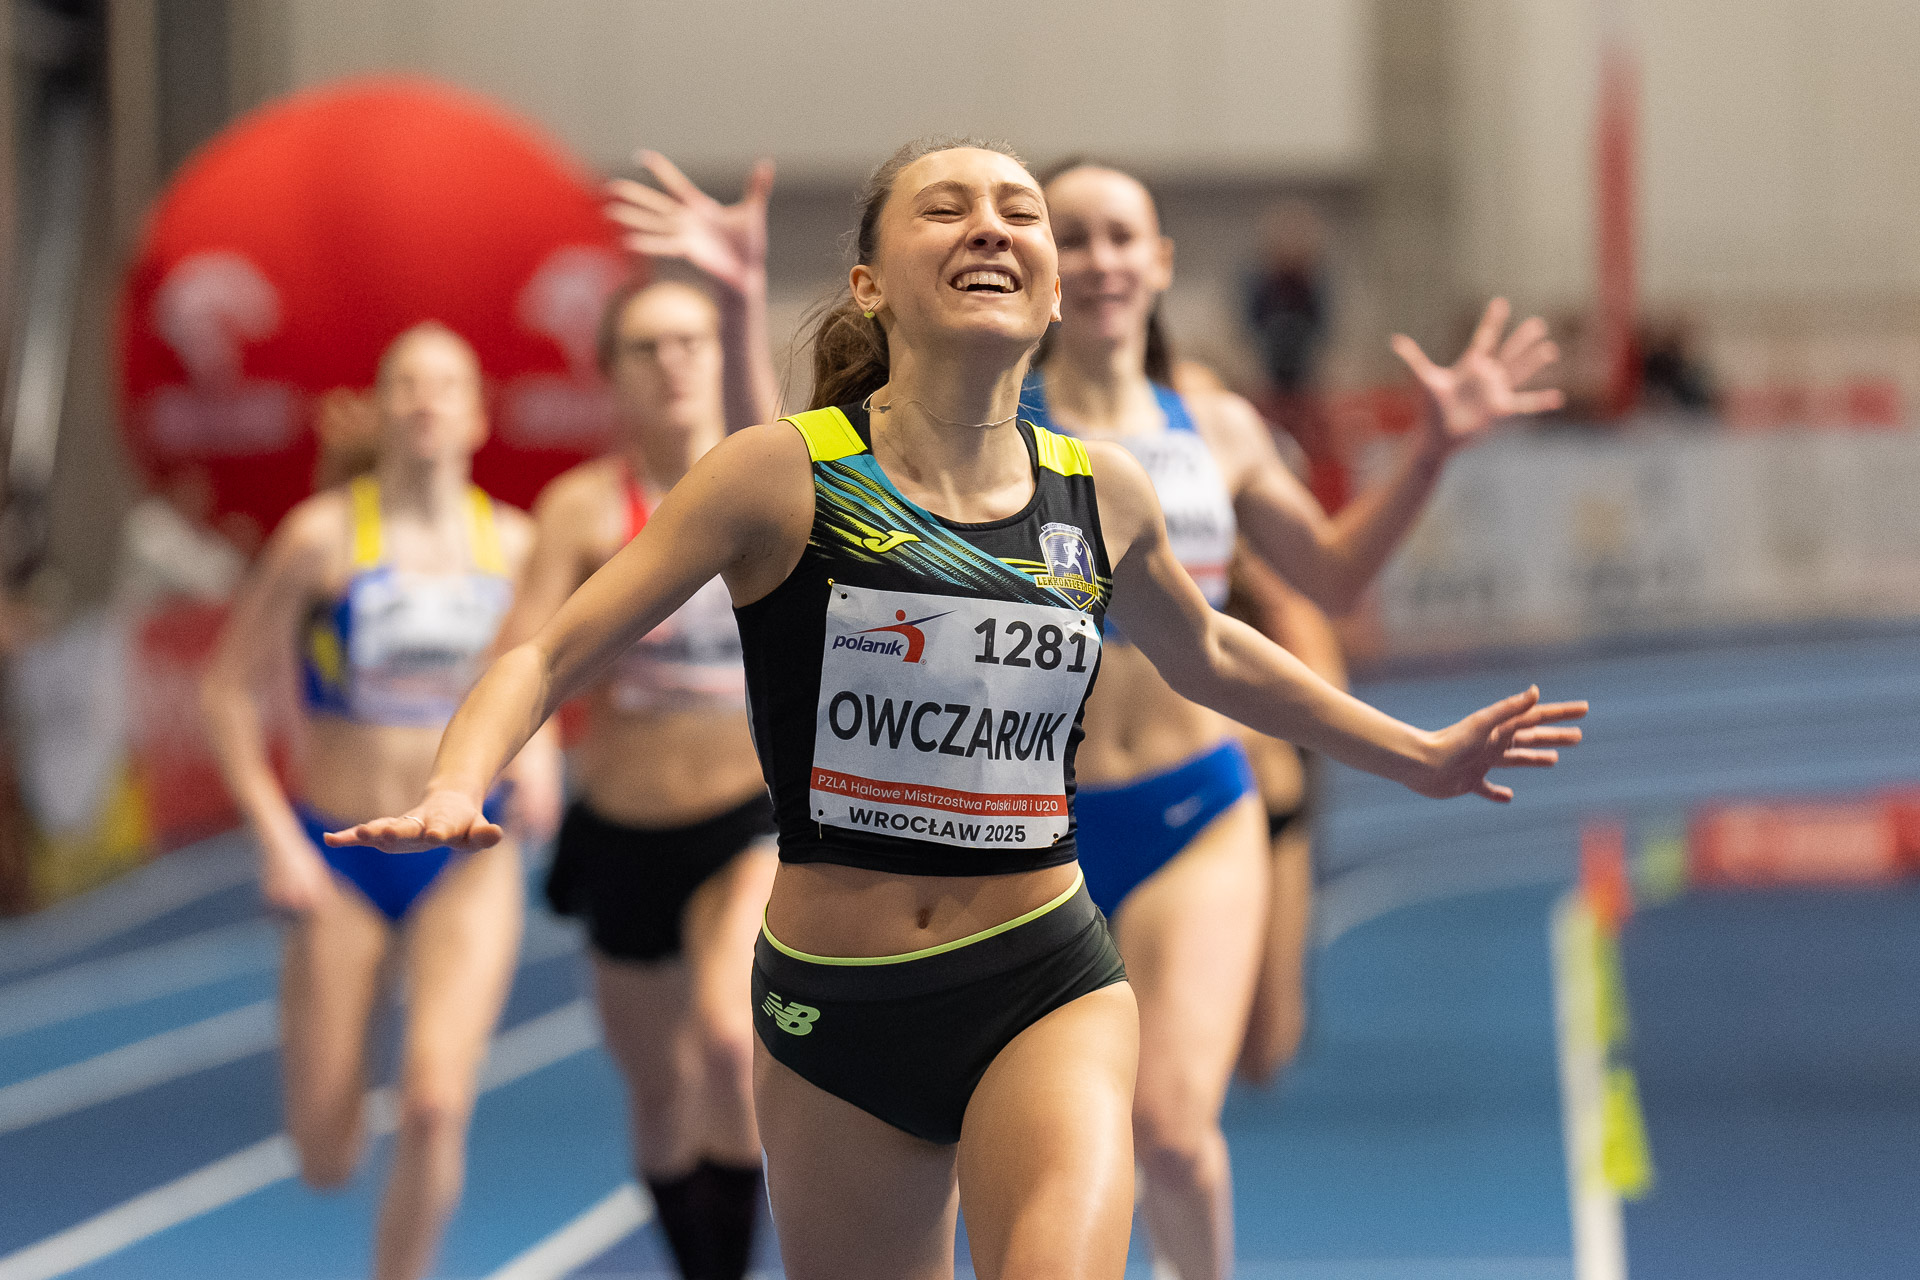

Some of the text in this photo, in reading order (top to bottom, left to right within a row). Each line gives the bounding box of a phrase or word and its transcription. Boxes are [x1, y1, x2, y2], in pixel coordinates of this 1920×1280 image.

[832, 635, 904, 657] polanik
[974, 617, 1088, 673] 1281
[828, 690, 1068, 762] OWCZARUK
[817, 774, 1059, 812] PZLA Halowe Mistrzostwa Polski U18 i U20
[849, 806, 1026, 843] WROCŁAW 2025
